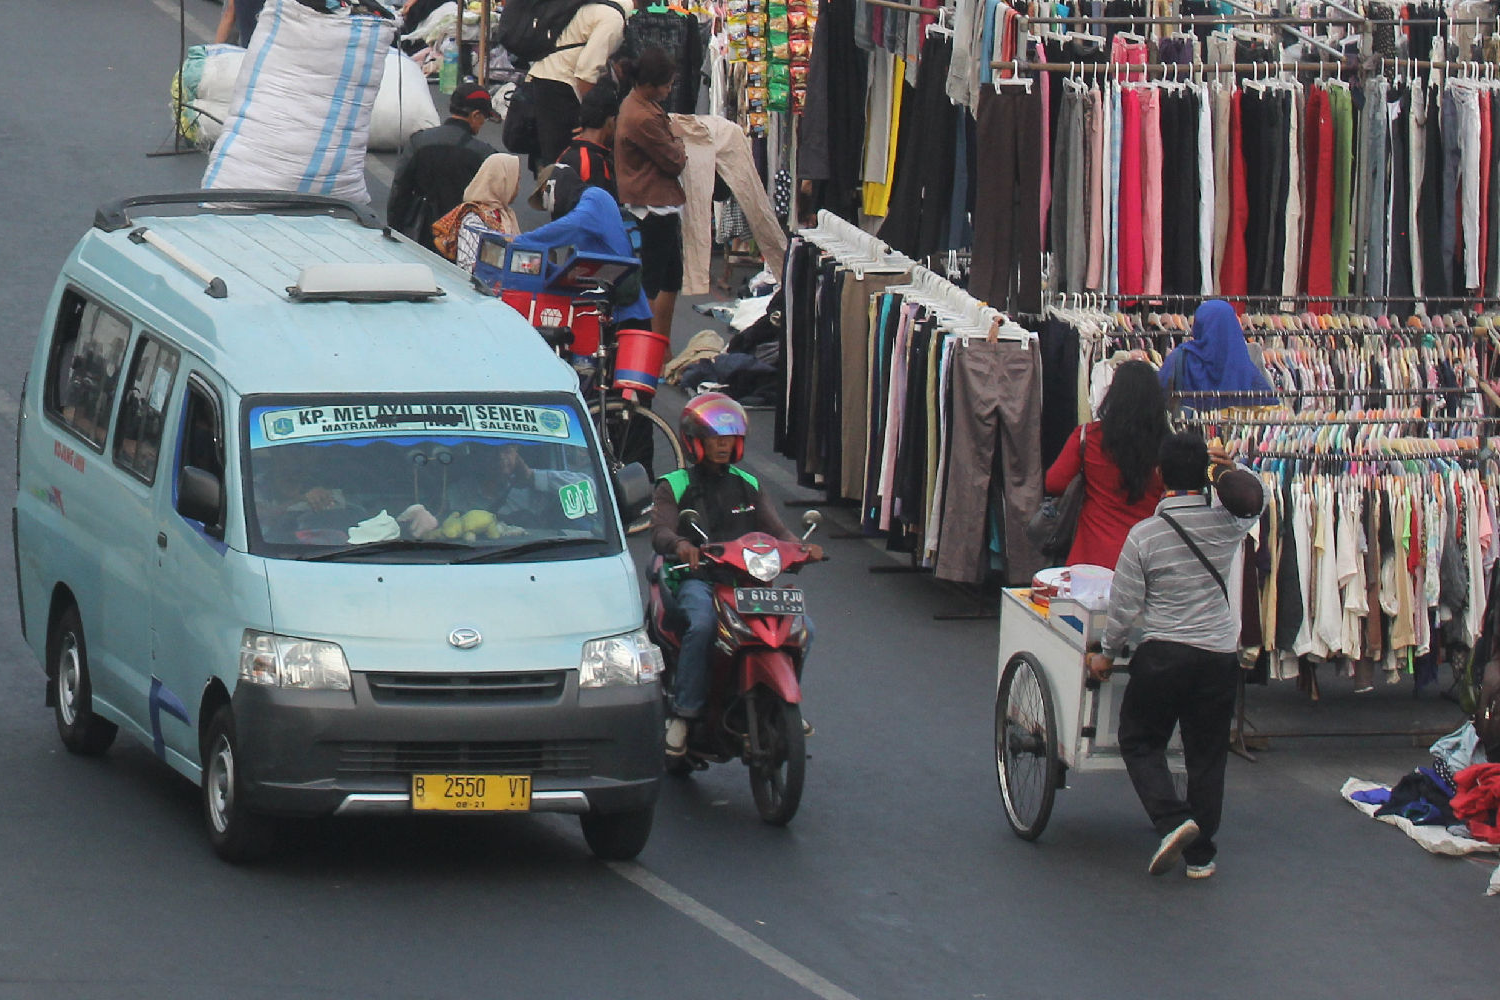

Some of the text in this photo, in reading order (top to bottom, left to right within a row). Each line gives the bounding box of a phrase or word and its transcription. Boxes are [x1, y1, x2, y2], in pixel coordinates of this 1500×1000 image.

[299, 409, 327, 426] KP.
[334, 405, 416, 424] MELAYU
[475, 405, 537, 424] SENEN
[322, 420, 539, 434] MATRAMAN SALEMBA
[737, 589, 803, 603] B 6126 PJU
[416, 777, 529, 798] B 2550 VT
